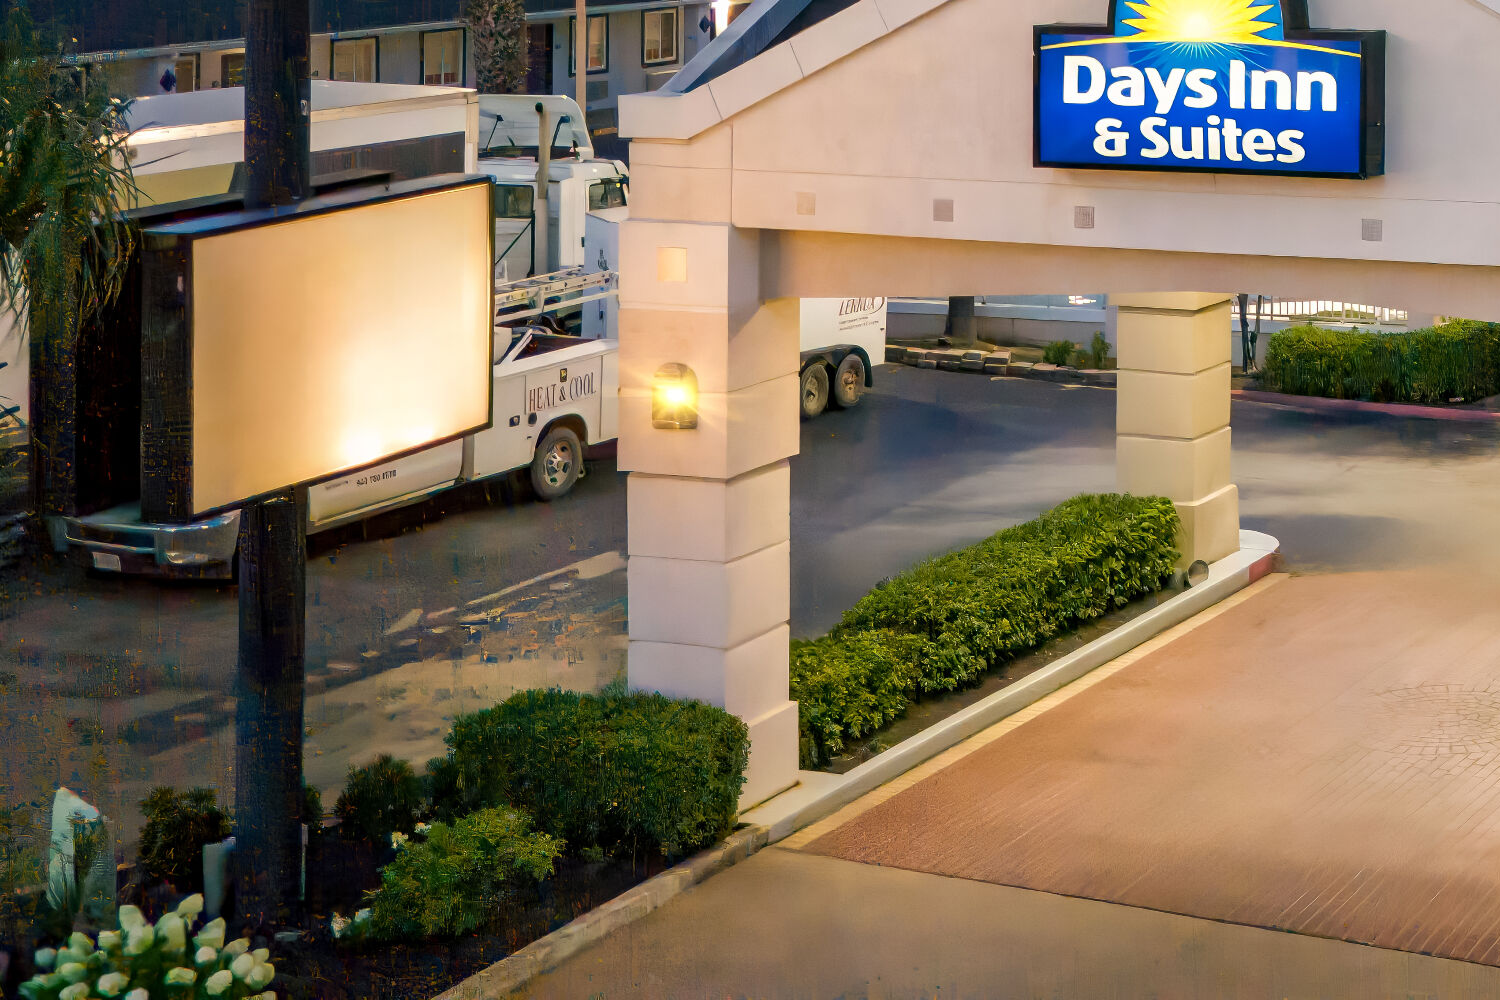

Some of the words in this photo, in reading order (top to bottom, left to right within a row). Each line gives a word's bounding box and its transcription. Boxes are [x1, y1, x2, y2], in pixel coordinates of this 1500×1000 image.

[1063, 55, 1218, 115] Days
[1229, 59, 1338, 112] Inn
[1092, 117, 1130, 158] &
[1140, 114, 1306, 164] Suites
[529, 383, 558, 413] HEAT
[559, 385, 567, 402] &
[569, 371, 597, 401] COOL
